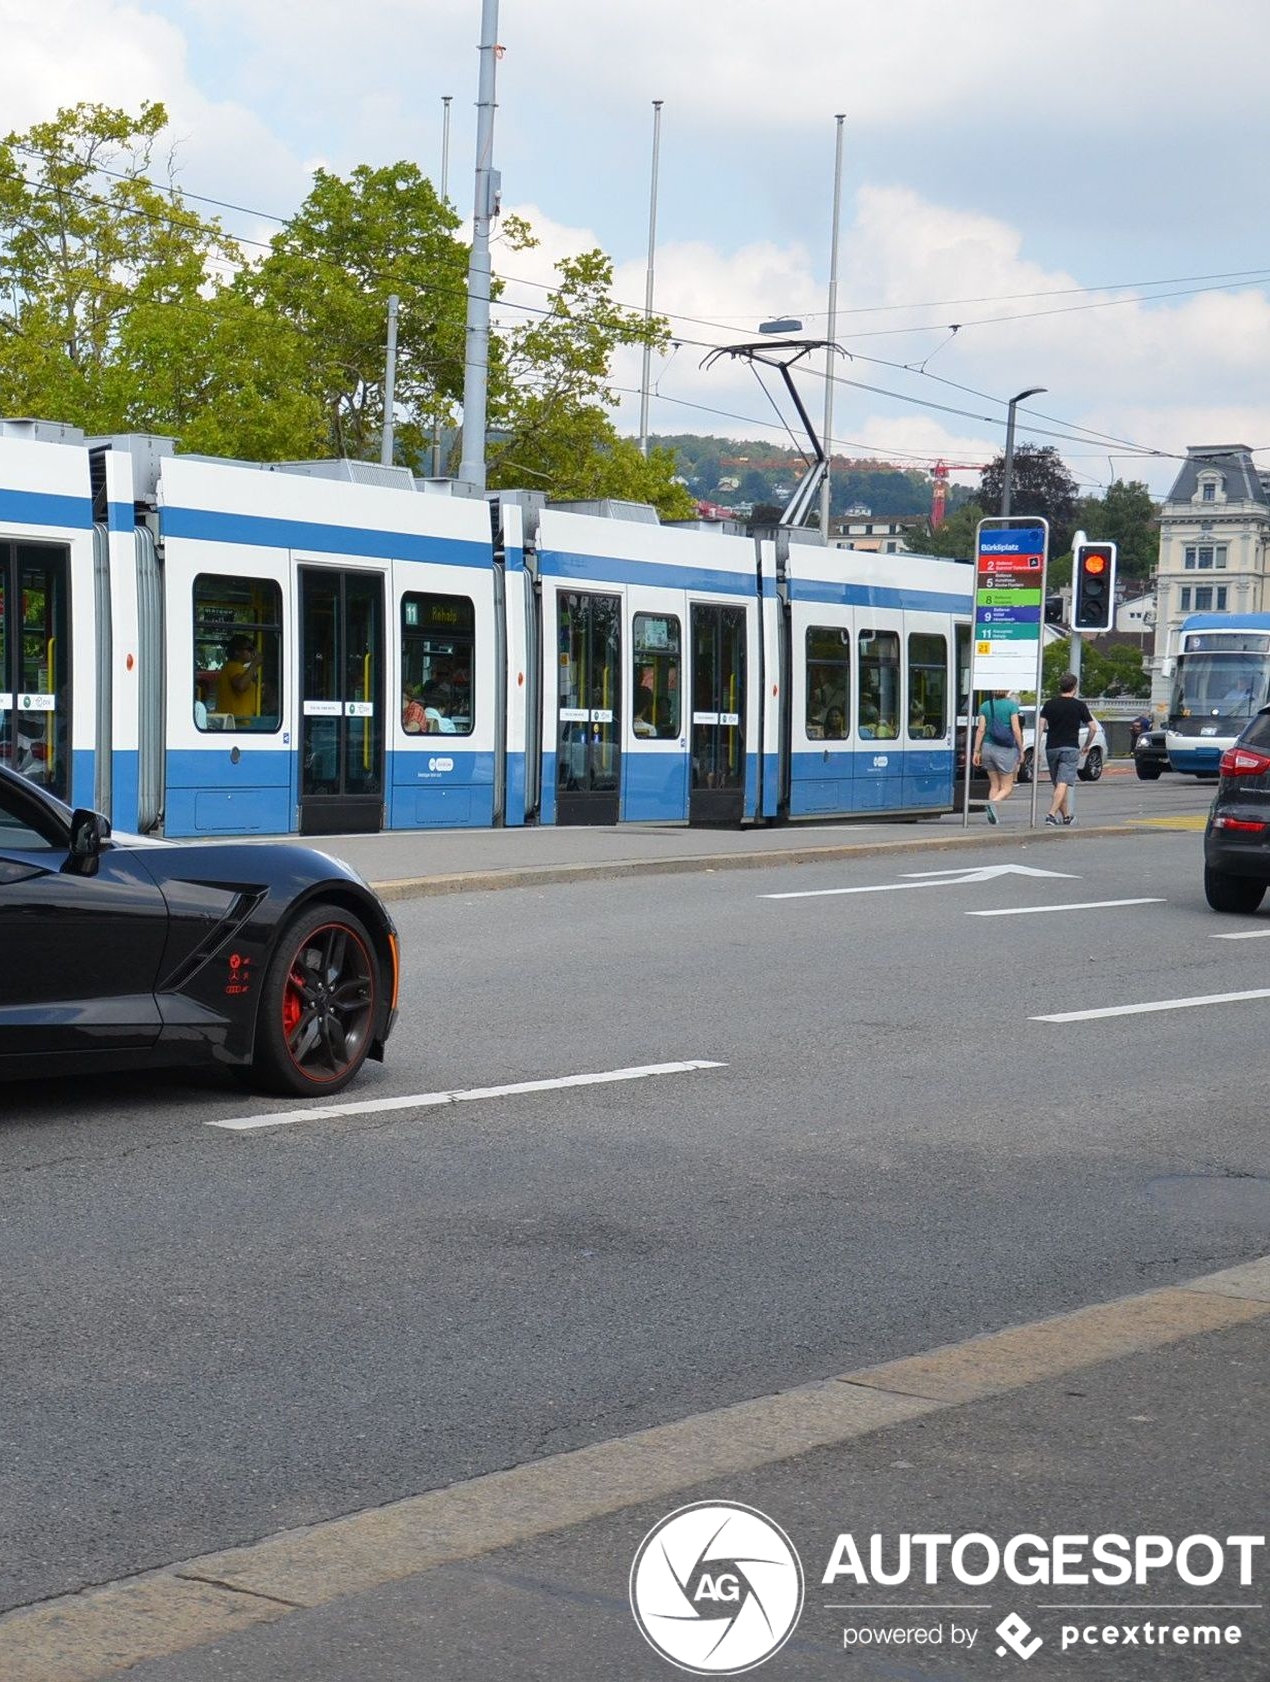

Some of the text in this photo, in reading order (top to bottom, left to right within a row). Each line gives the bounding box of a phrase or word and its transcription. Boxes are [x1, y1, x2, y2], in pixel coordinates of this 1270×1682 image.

[980, 543, 1019, 552] Bürkliplatz
[986, 561, 995, 571] 2
[986, 578, 994, 588] 5
[985, 595, 993, 605] 8
[406, 606, 417, 623] 11
[984, 612, 992, 622] 9
[981, 629, 992, 639] 11
[1192, 637, 1202, 648] 9
[977, 643, 989, 653] 21
